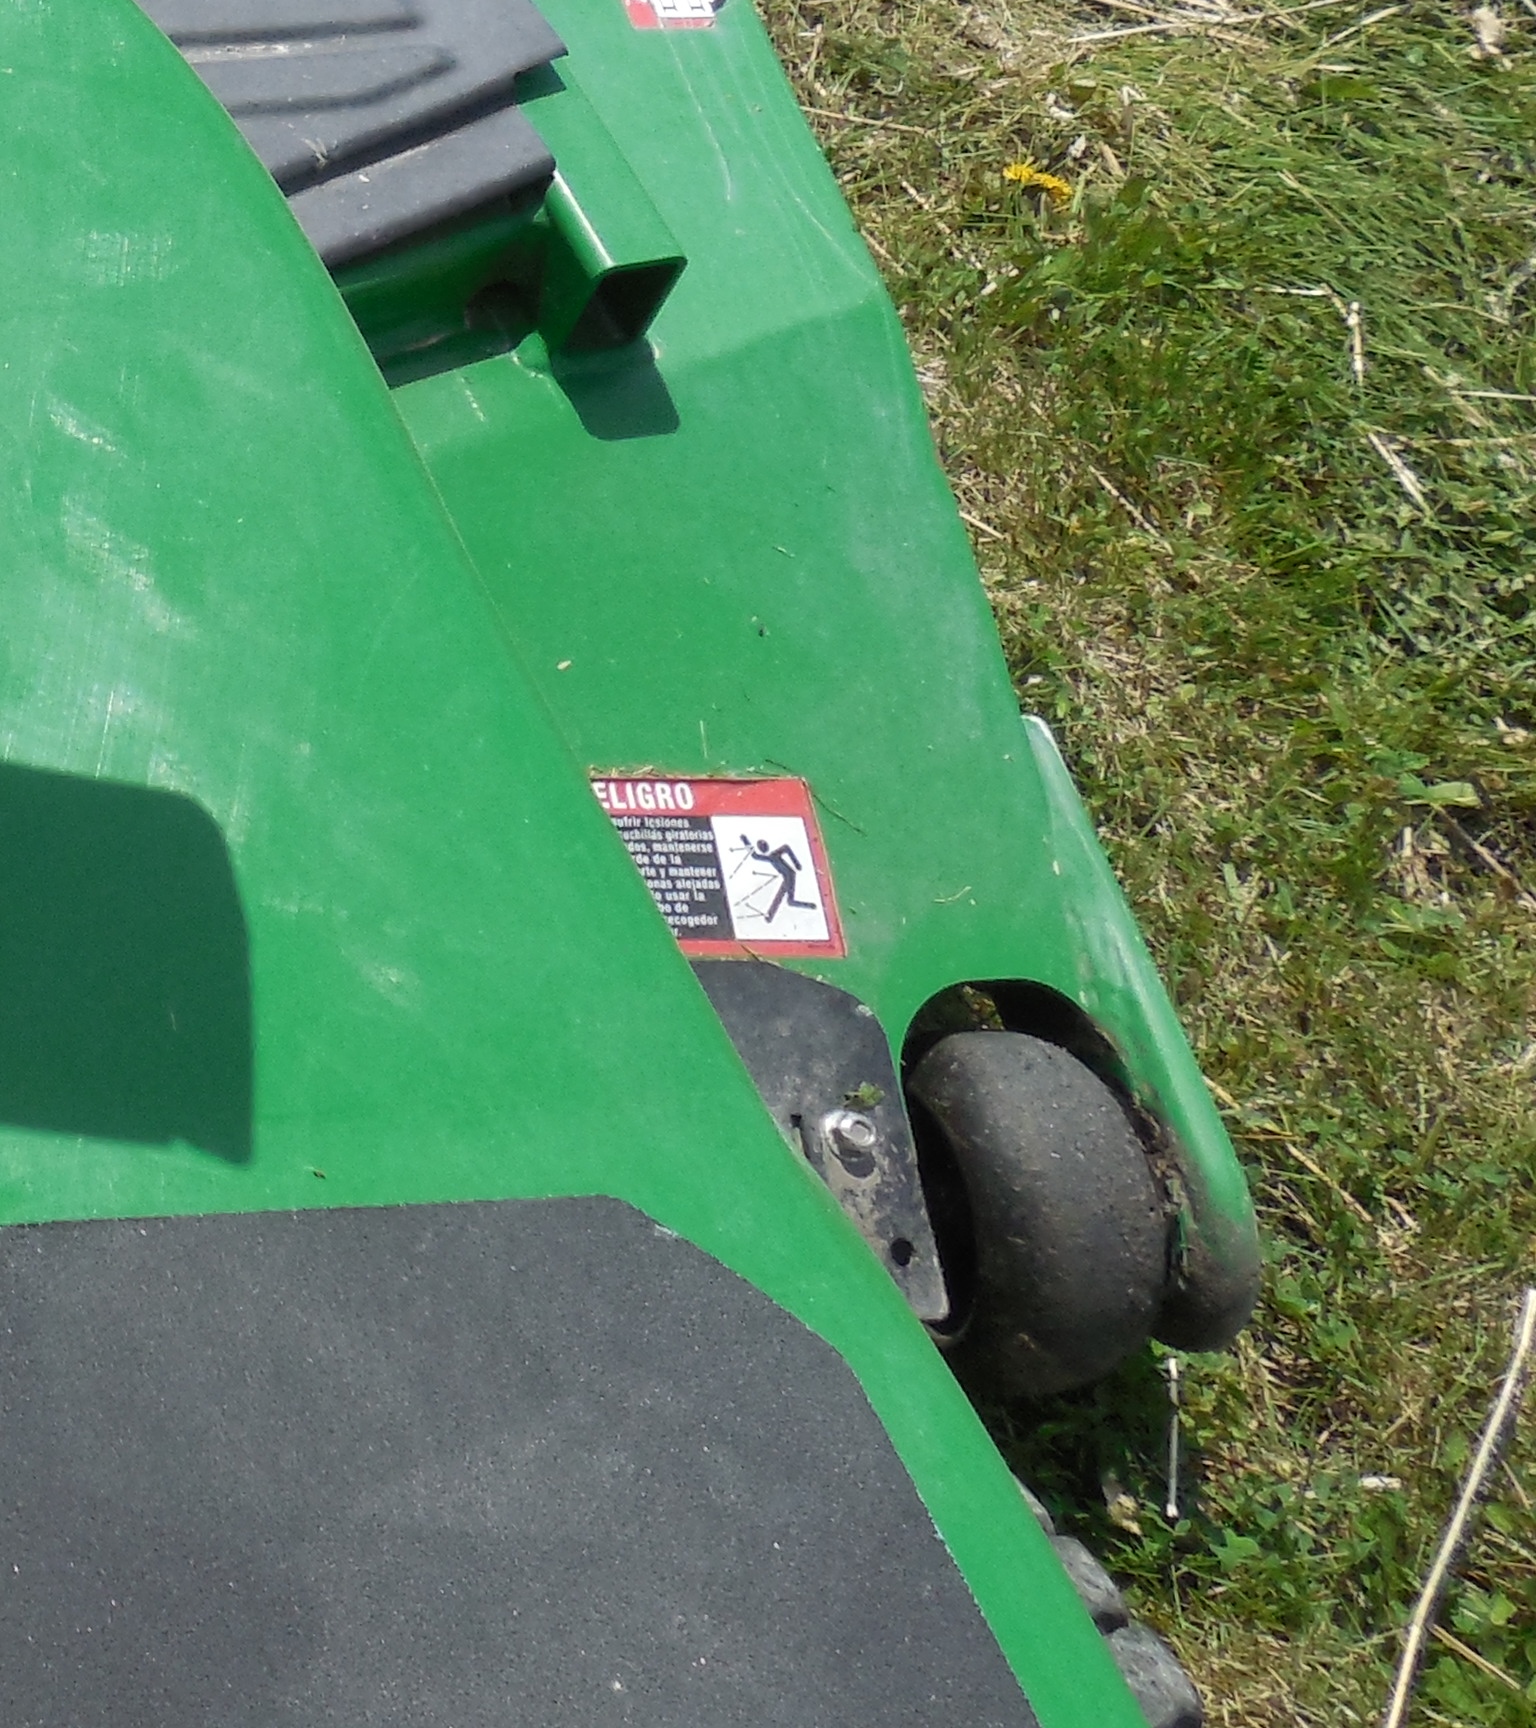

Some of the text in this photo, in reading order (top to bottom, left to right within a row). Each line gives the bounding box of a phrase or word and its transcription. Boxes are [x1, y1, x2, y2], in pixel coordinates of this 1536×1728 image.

[592, 781, 694, 810] ELIGRO
[644, 816, 689, 829] lesiones
[619, 829, 715, 842] uchillas giratorias
[652, 842, 714, 853] mantenerse
[653, 853, 667, 865] de
[670, 853, 682, 865] la
[659, 867, 666, 879] y
[668, 866, 717, 878] mantener
[675, 877, 721, 890] alejadas
[666, 891, 689, 901] usar
[675, 902, 689, 913] de
